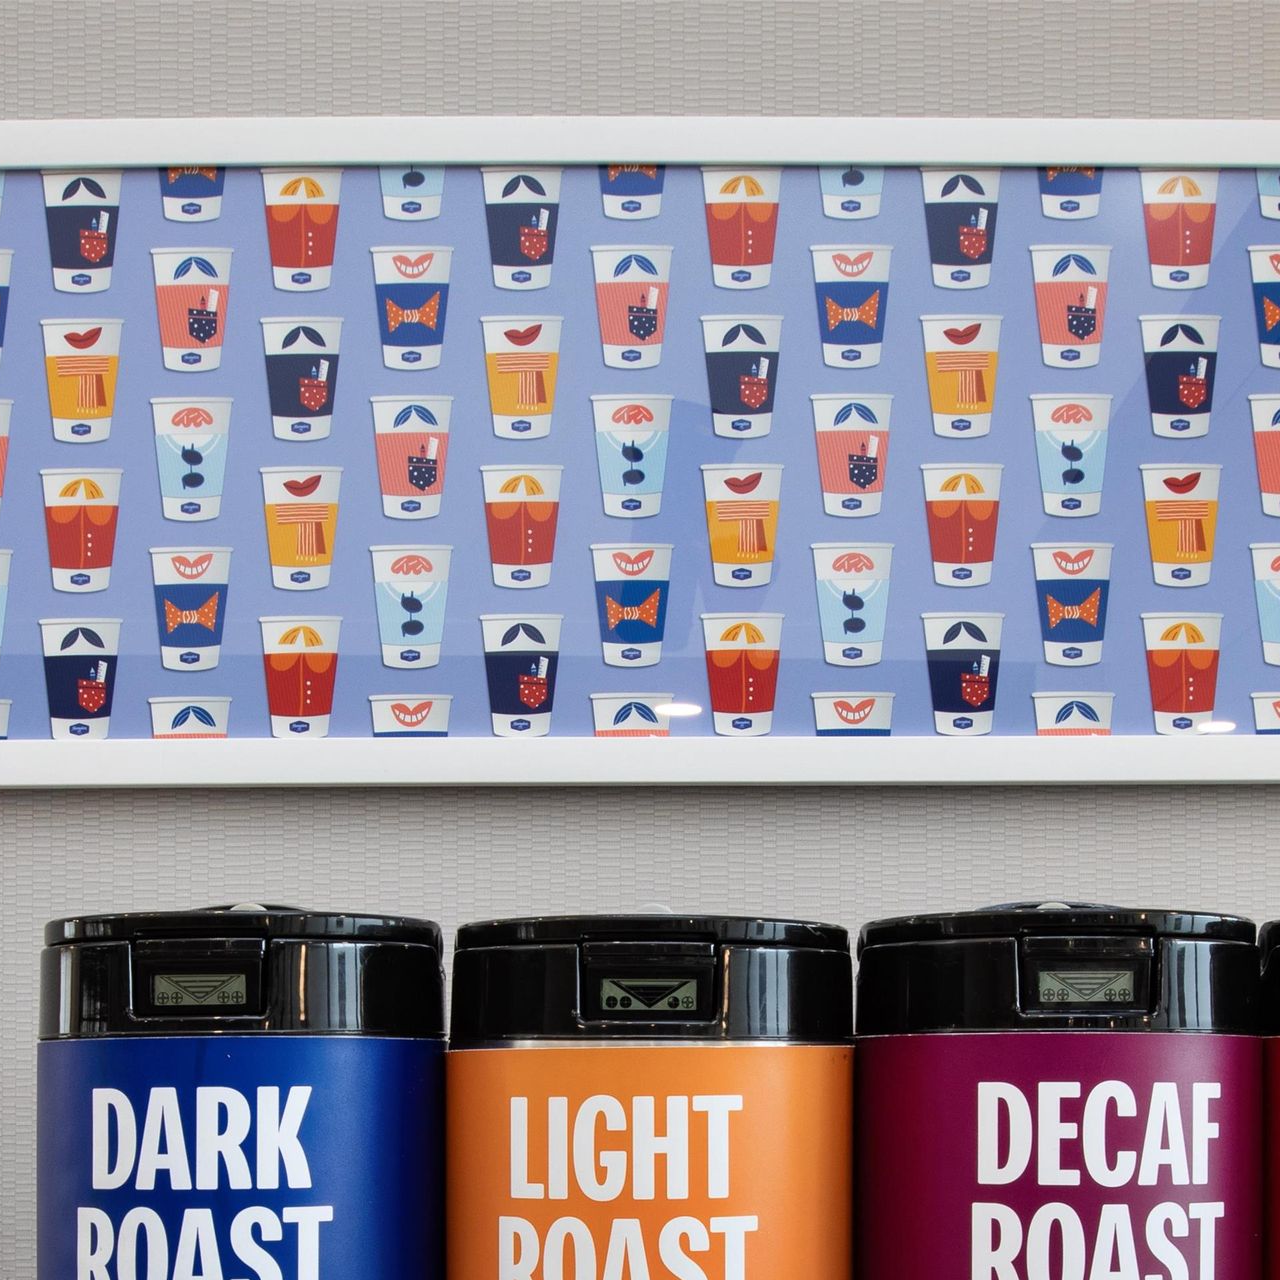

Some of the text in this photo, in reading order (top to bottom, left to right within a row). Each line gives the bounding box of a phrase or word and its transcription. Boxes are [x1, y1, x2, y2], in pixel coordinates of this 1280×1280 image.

[92, 1085, 313, 1191] DARK
[510, 1094, 743, 1202] LIGHT
[977, 1080, 1221, 1187] DECAF
